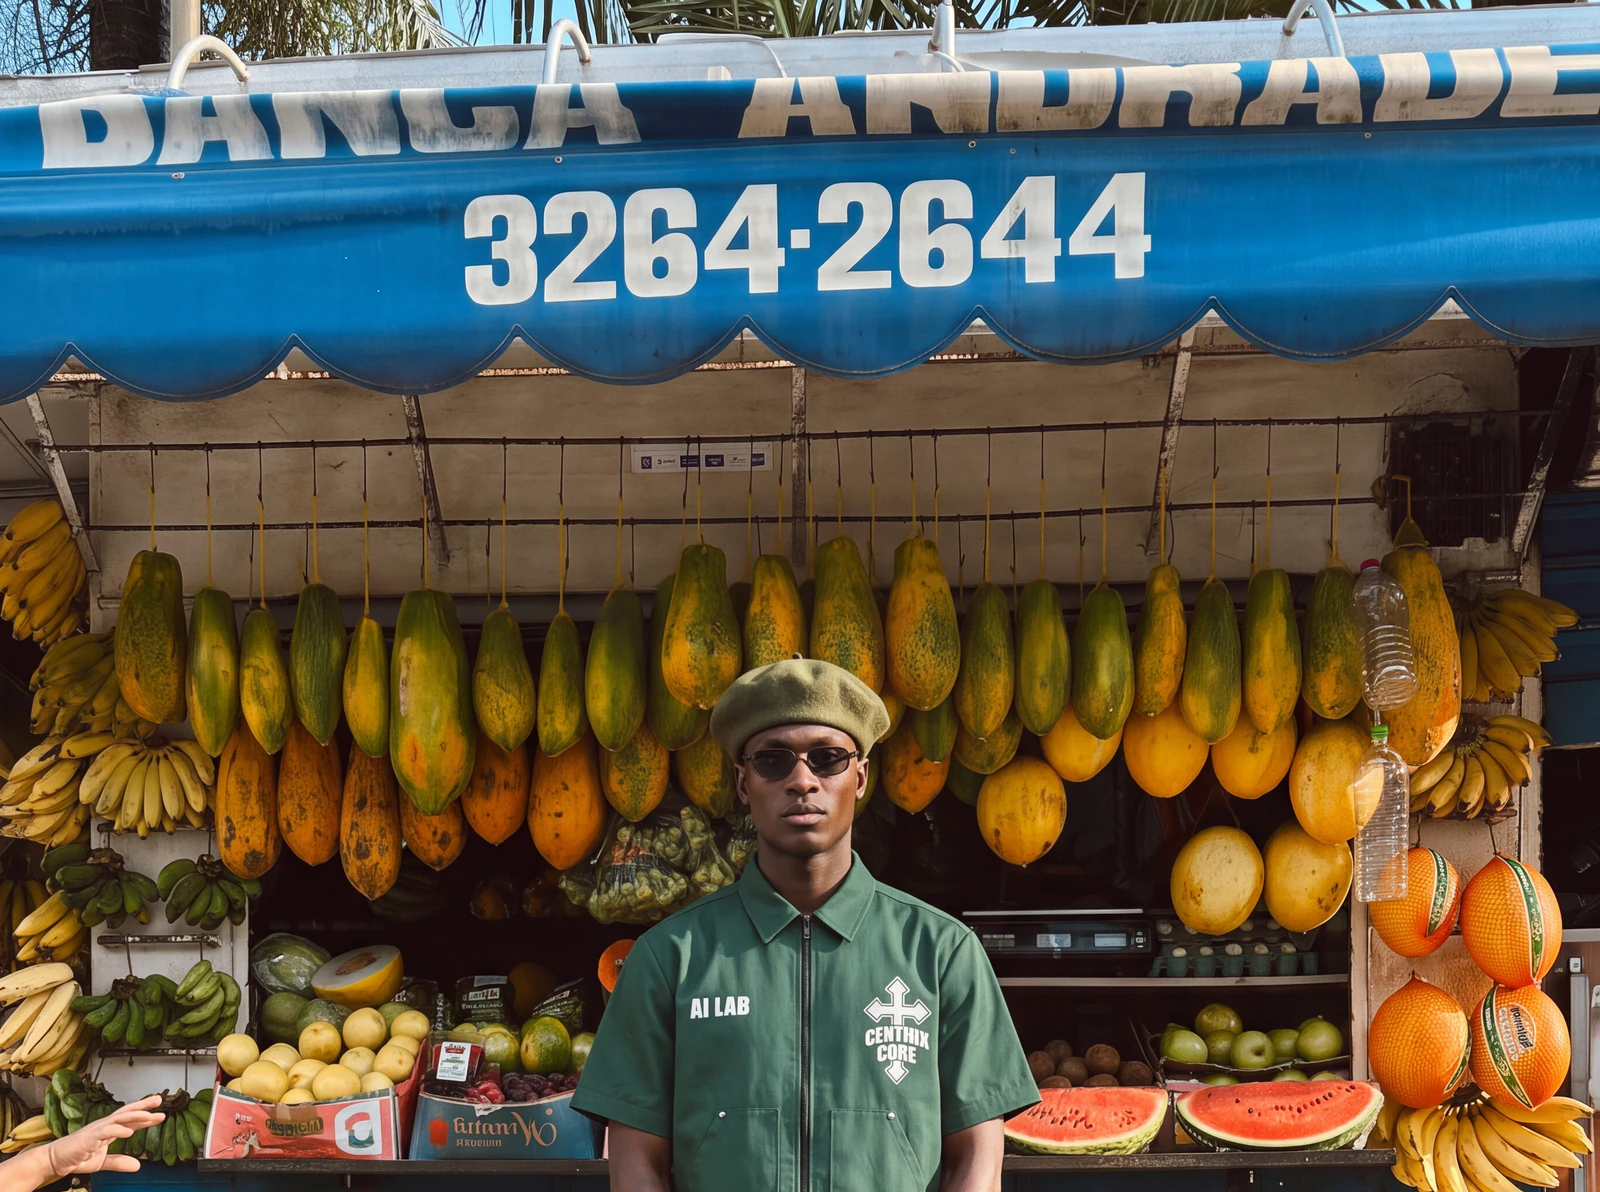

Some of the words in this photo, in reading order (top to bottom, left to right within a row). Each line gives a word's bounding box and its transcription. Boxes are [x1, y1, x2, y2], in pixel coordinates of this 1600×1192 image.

[690, 997, 709, 1019] AI
[714, 995, 750, 1017] LAB
[865, 1025, 930, 1051] CENTHIX
[877, 1043, 917, 1065] CORE
